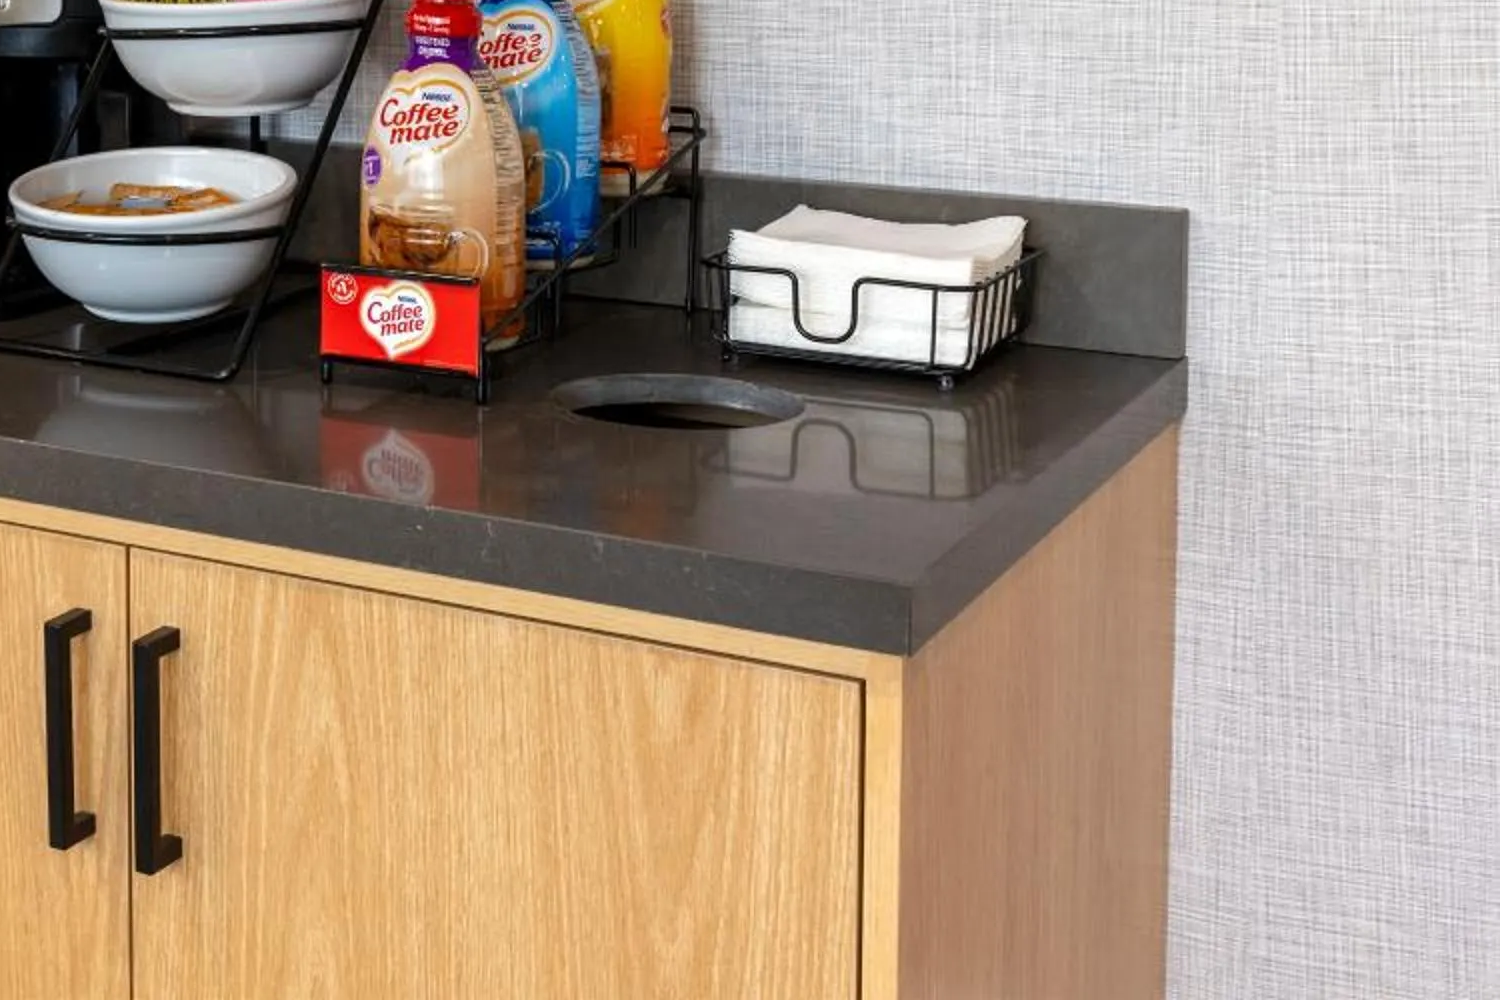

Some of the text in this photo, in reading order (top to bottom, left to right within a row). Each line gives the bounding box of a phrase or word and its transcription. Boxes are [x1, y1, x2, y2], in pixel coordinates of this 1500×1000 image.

[479, 32, 542, 54] offee
[380, 97, 459, 127] Coffee
[389, 120, 460, 145] mate
[367, 301, 423, 324] Coffee
[380, 317, 425, 337] mate
